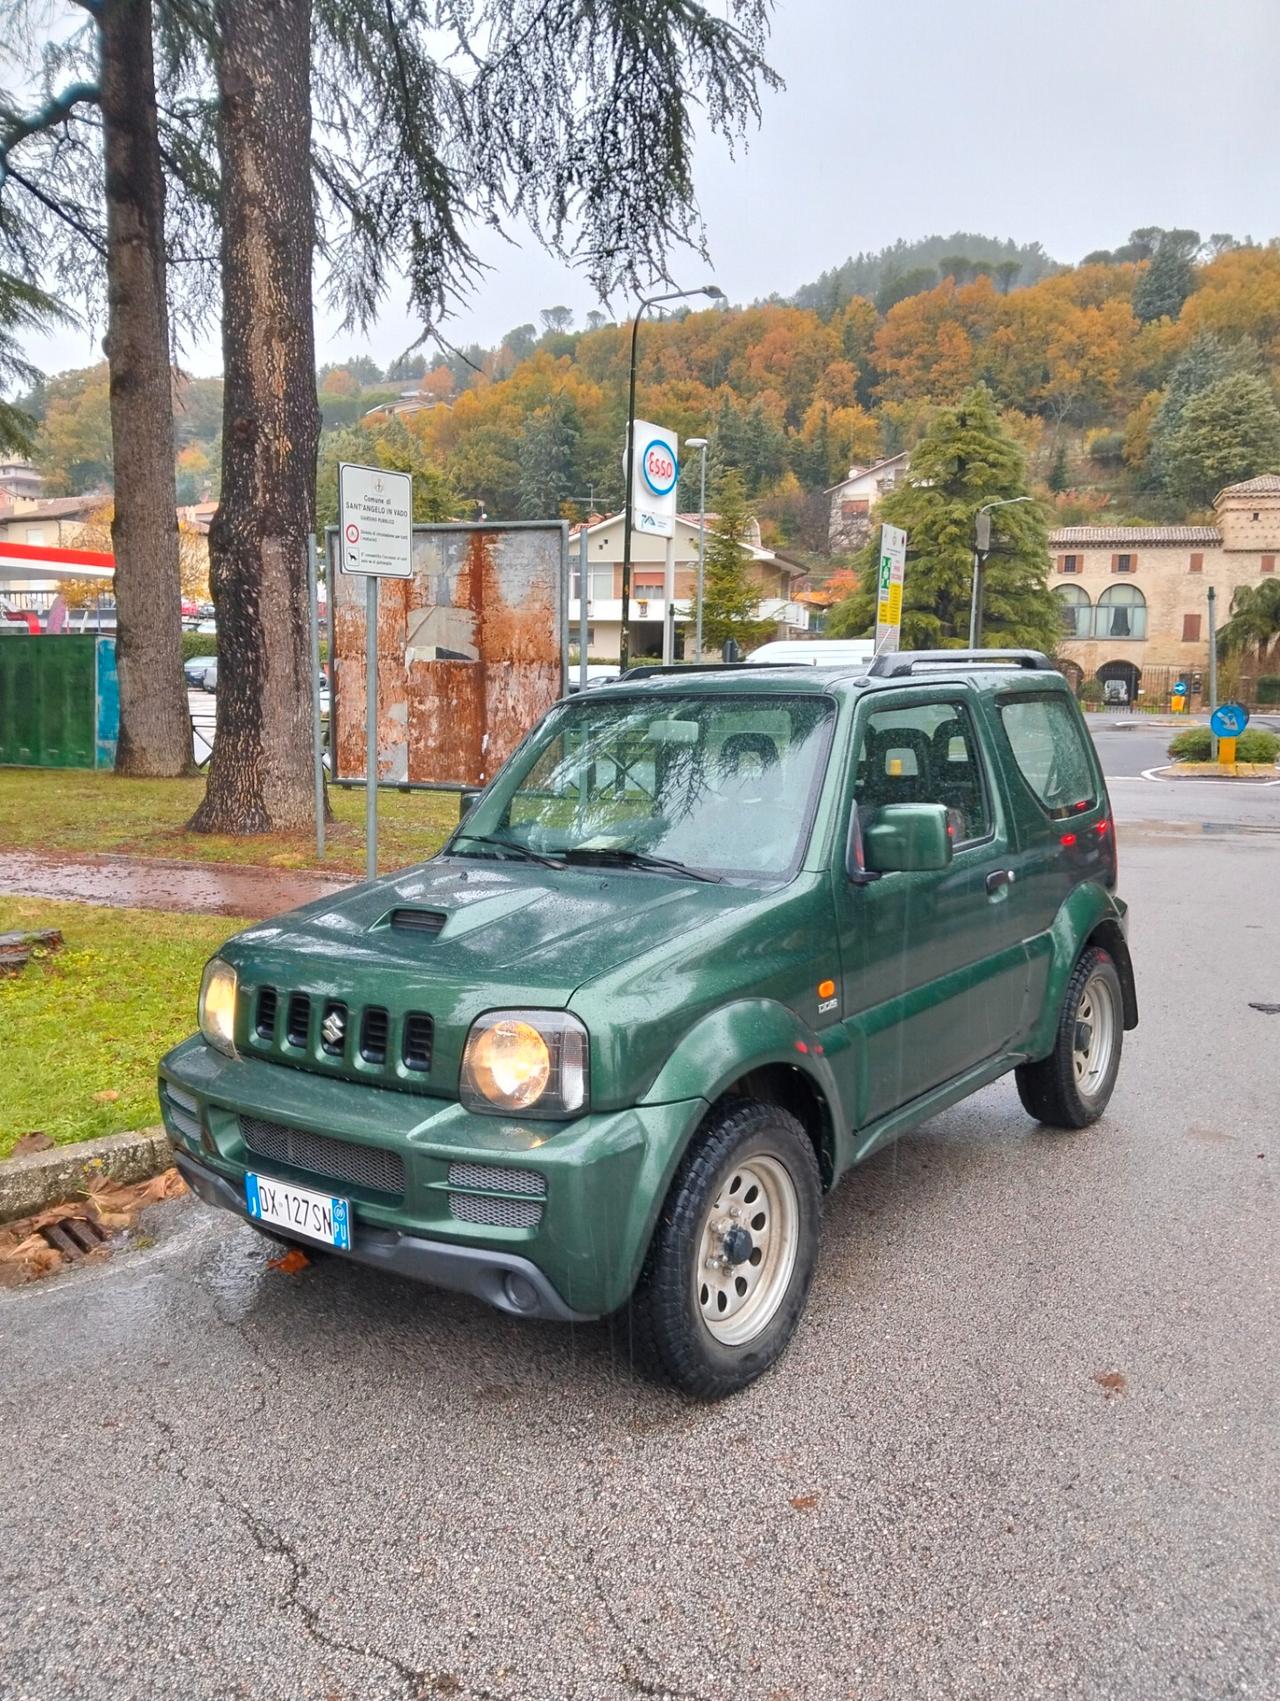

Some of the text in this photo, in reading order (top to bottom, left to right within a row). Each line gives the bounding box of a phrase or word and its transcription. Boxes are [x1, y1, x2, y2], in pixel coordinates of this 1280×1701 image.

[363, 494, 384, 504] Comune
[345, 501, 386, 514] SANT'ANGELO
[393, 509, 408, 518] VADO
[334, 1221, 347, 1241] PU
